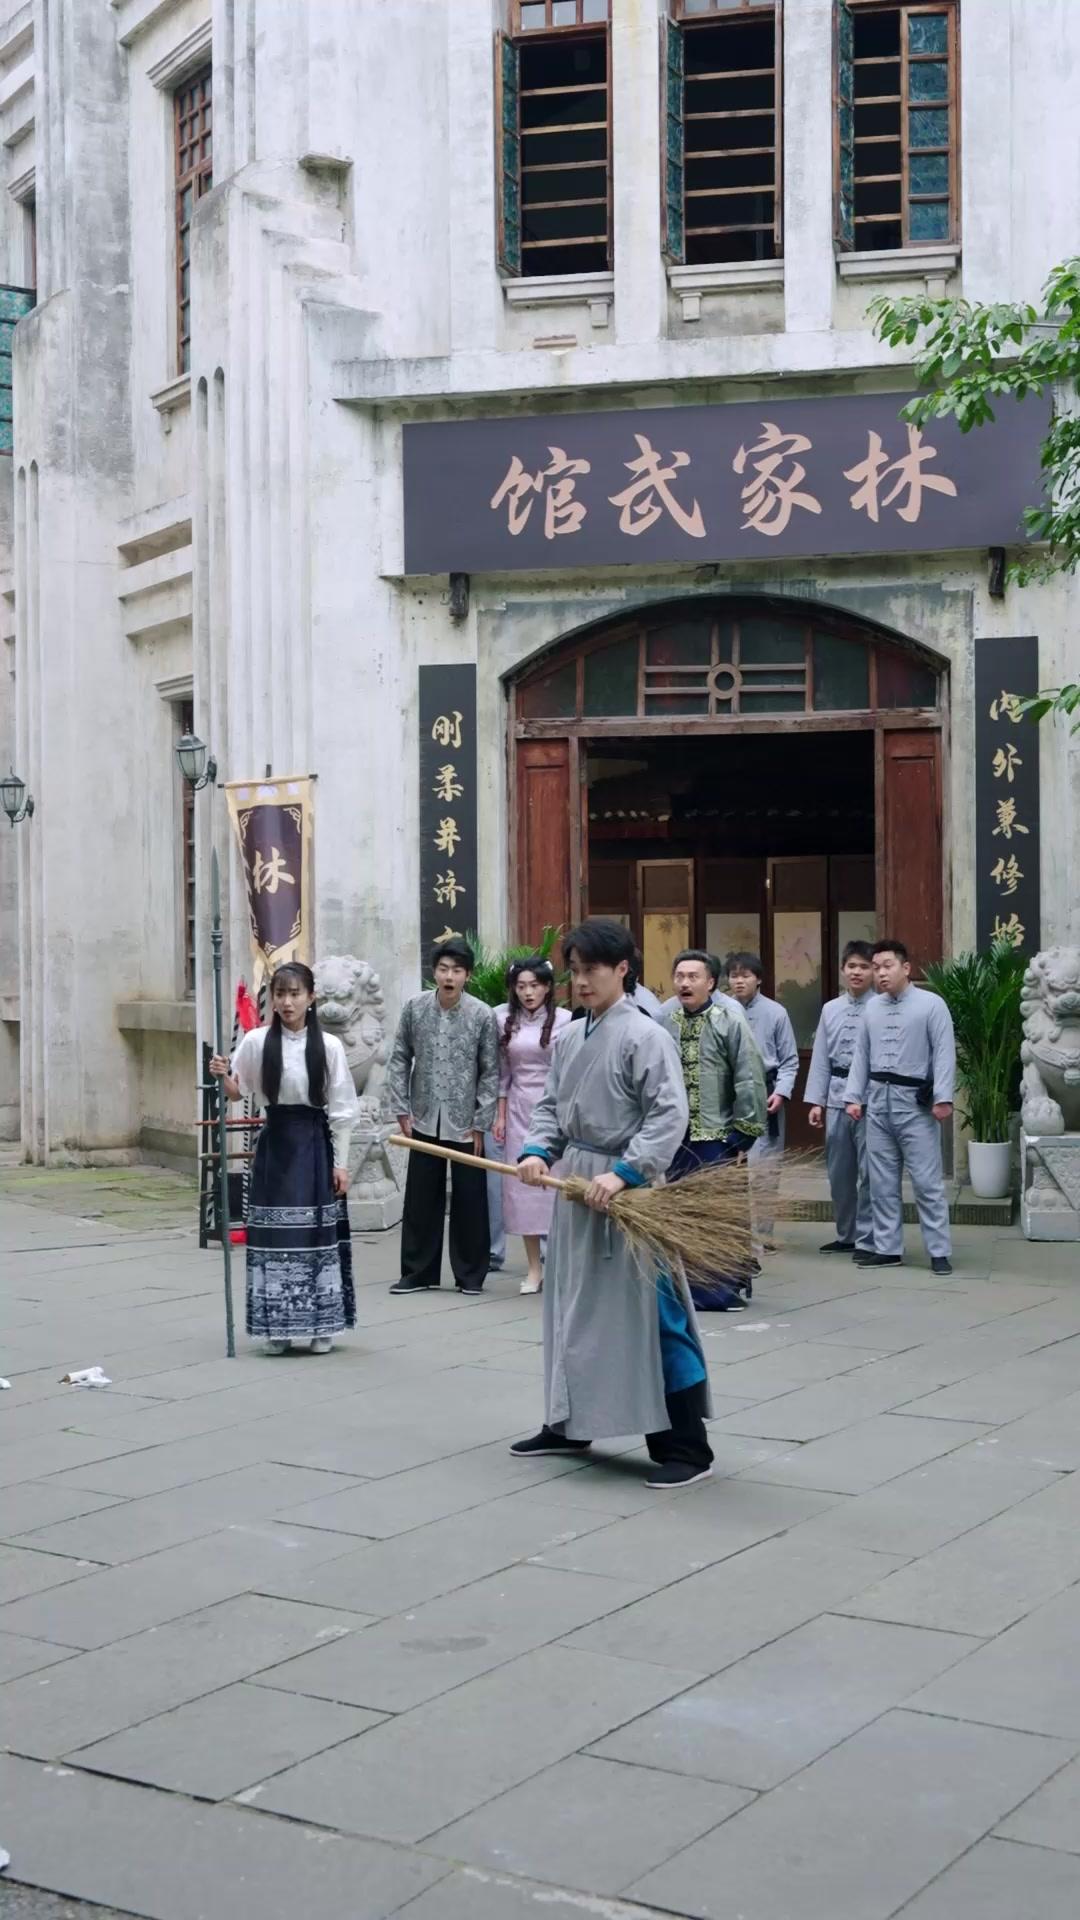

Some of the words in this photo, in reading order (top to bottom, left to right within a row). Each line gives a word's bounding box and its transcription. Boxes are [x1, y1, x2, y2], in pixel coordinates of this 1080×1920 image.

[490, 421, 958, 540] 林家武馆
[253, 846, 295, 894] 林
